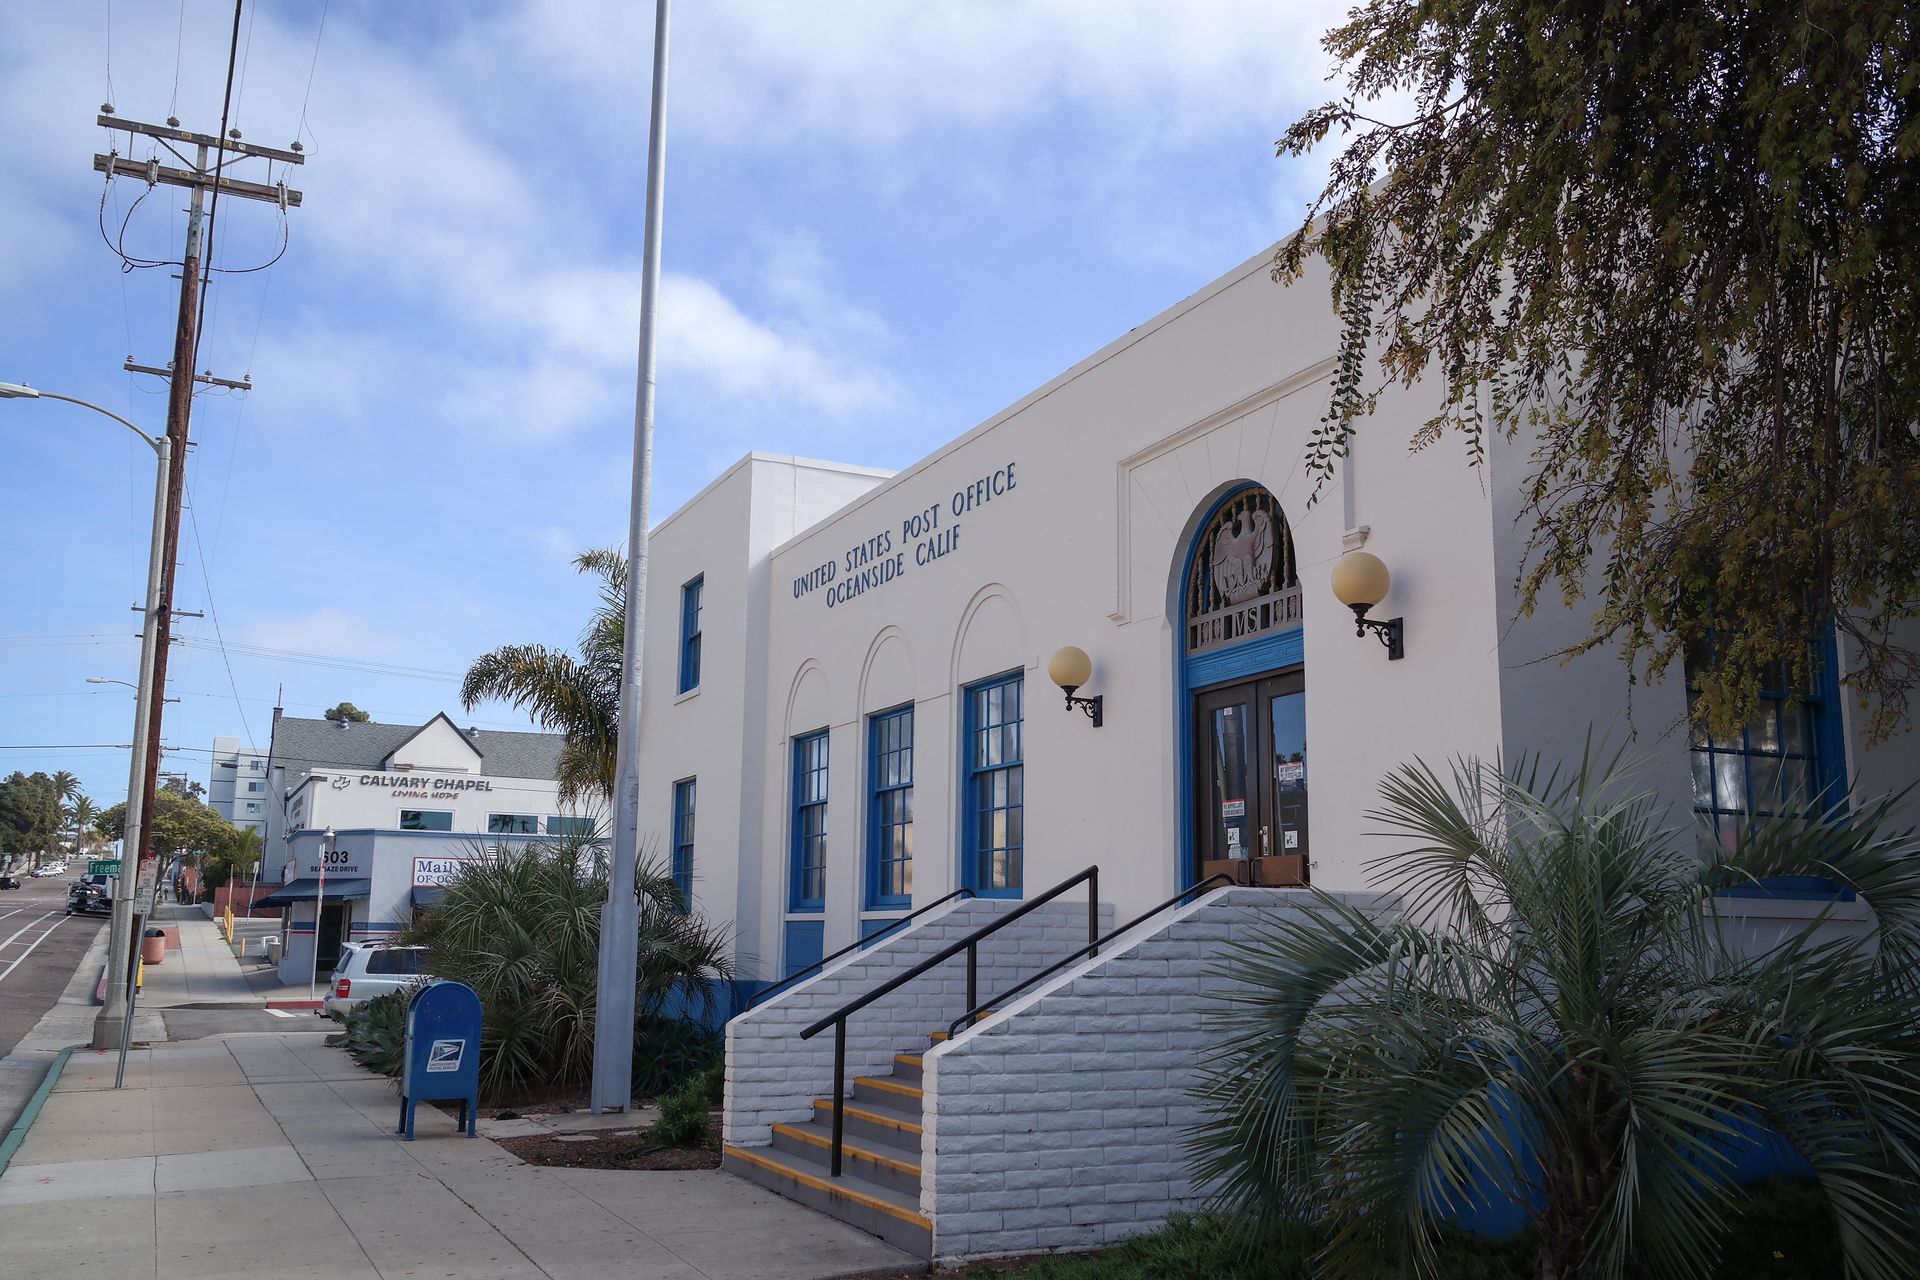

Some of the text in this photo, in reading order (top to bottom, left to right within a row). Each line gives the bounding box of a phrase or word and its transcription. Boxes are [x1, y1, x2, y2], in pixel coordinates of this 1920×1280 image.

[793, 462, 1017, 599] UNITED STATES POST OFFICE
[826, 523, 961, 608] OCEANSIDE CALIF
[359, 775, 493, 791] CALVARY CHAPEL
[392, 789, 460, 800] LIVING HOPE
[417, 860, 453, 873] Mail
[416, 874, 433, 884] OF
